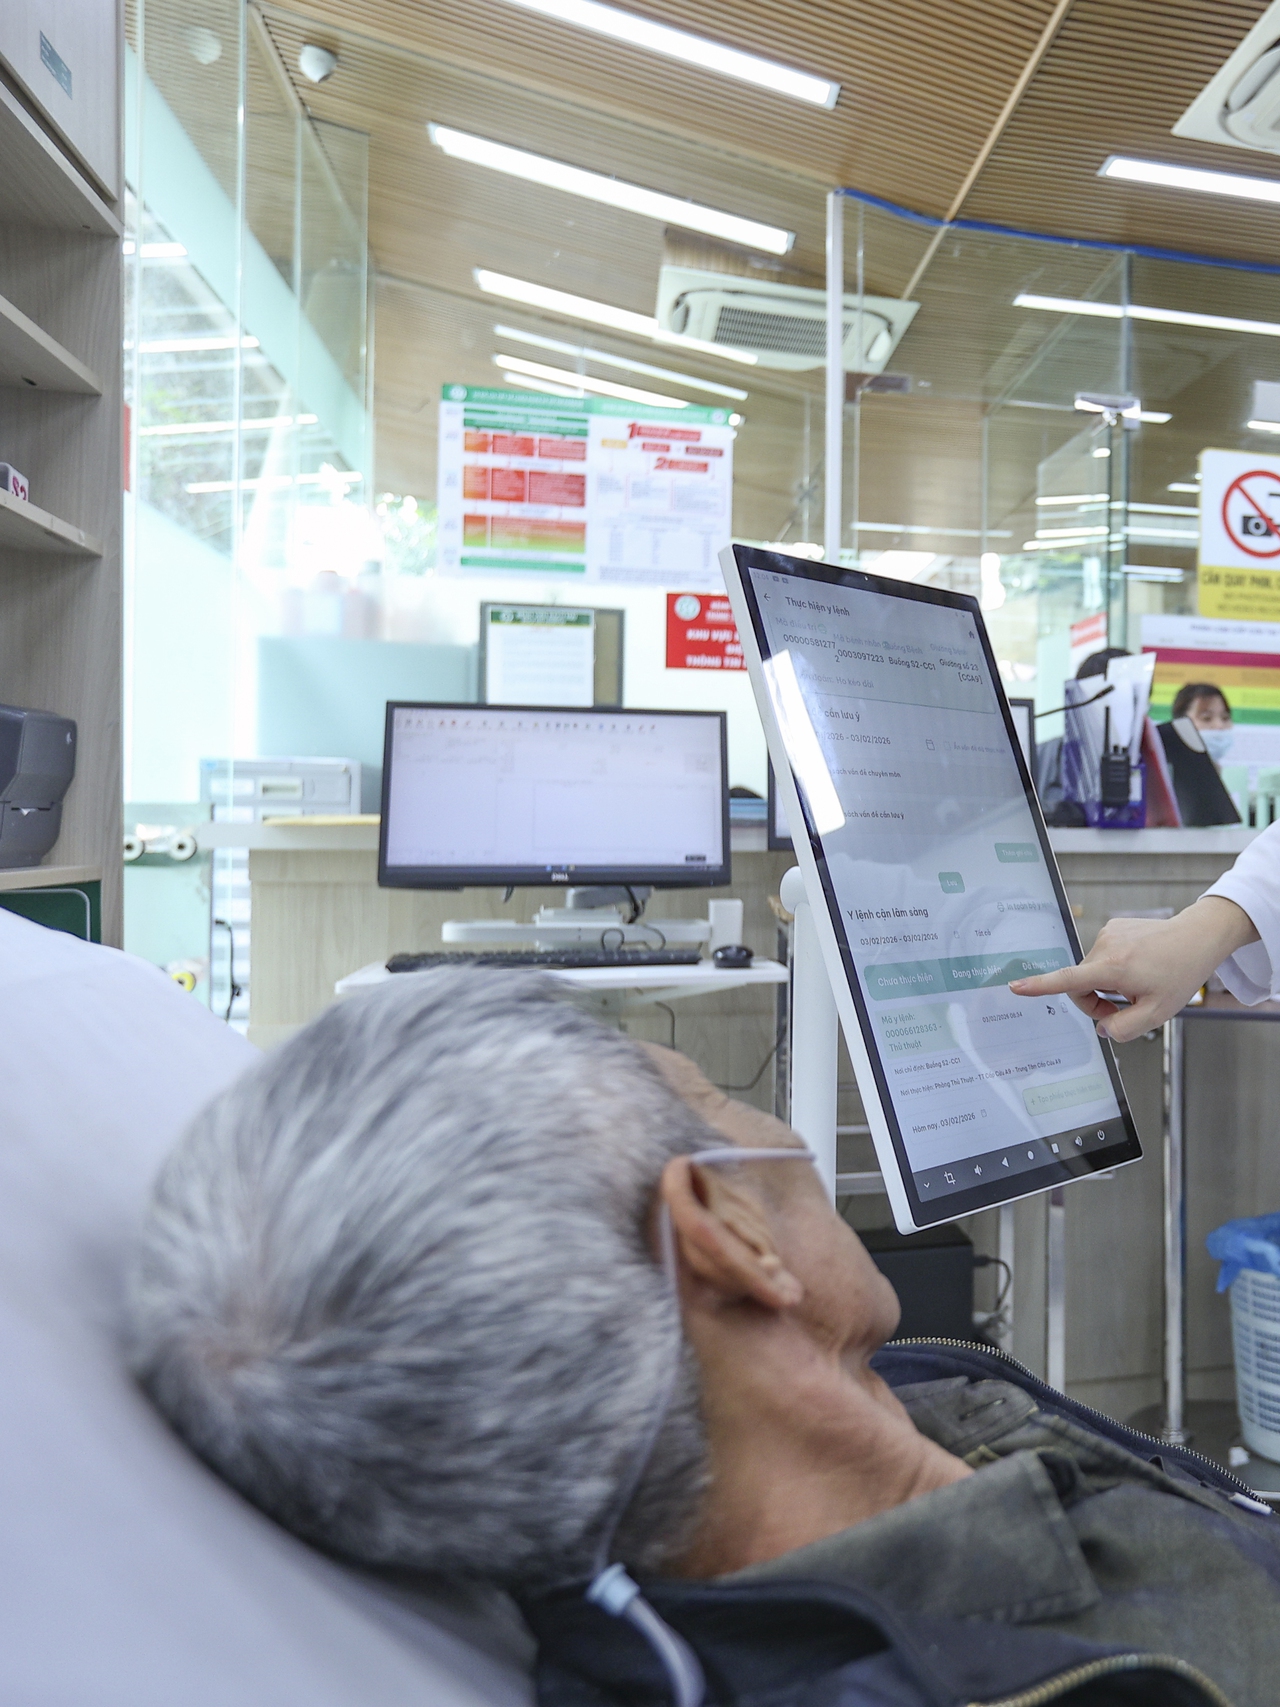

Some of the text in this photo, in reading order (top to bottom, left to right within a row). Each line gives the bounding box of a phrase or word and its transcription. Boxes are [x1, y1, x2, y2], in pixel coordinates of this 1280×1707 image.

[785, 596, 807, 609] Thực
[808, 600, 827, 614] hiện
[833, 605, 851, 617] lệnh
[847, 910, 854, 920] Y
[855, 909, 874, 922] lệnh
[875, 908, 892, 921] cận
[908, 906, 929, 918] sàng
[860, 935, 898, 946] 03/02/2026
[903, 933, 939, 943] 03/02/2026
[952, 969, 971, 978] Đang
[971, 966, 987, 976] thực
[877, 972, 934, 987] Chưa thực hiện
[881, 1015, 893, 1025] Mã
[912, 1124, 927, 1134] Hôm
